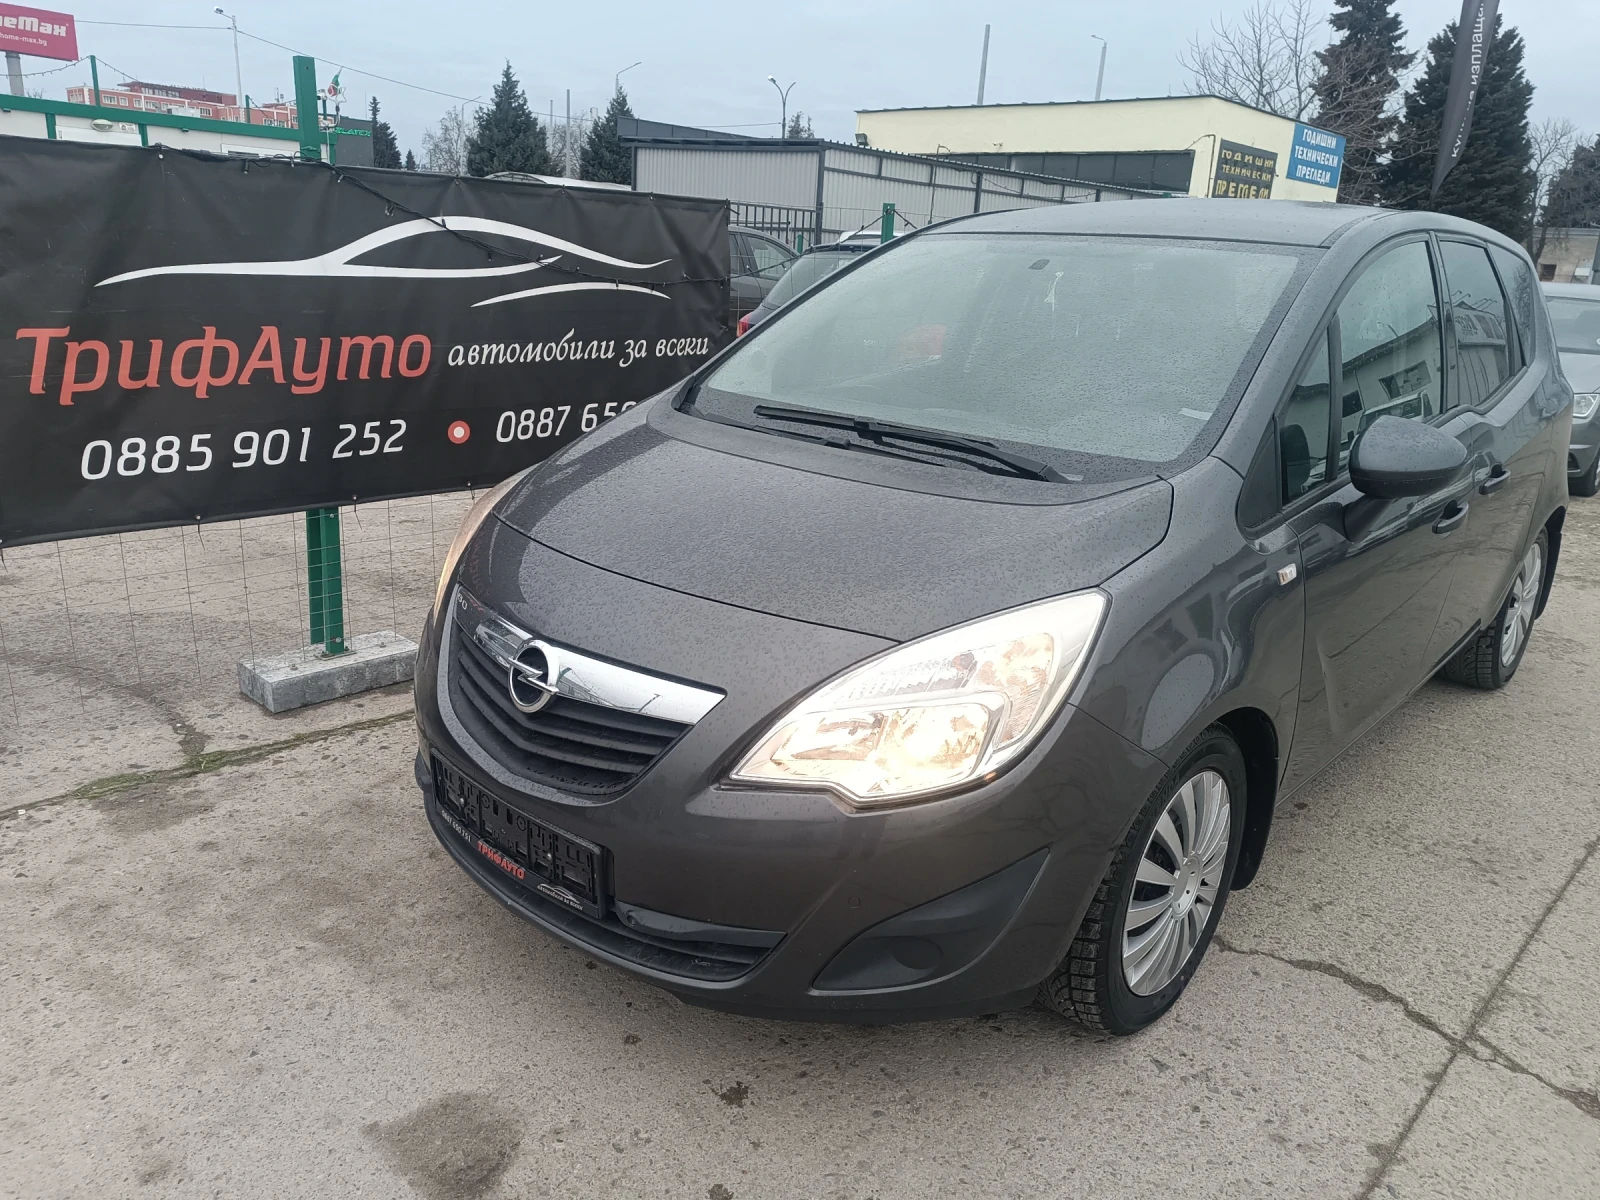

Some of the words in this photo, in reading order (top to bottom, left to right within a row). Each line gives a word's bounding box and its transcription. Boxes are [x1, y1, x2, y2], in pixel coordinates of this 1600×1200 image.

[0, 15, 67, 37] eMax
[1303, 128, 1337, 149] ГОДИШНИ
[1294, 145, 1339, 168] ТЕХНИЧЕСКИ
[1296, 164, 1331, 185] ПРЕГЛЕДИ
[16, 325, 432, 406] ТрифАуто
[448, 328, 615, 367] автомобили
[619, 338, 647, 368] за
[655, 337, 709, 357] всеки
[81, 433, 213, 481] 0885
[231, 427, 311, 469] 901
[332, 419, 407, 460] 252
[495, 405, 571, 443] 0887
[477, 840, 525, 880] ТРИФАУТО
